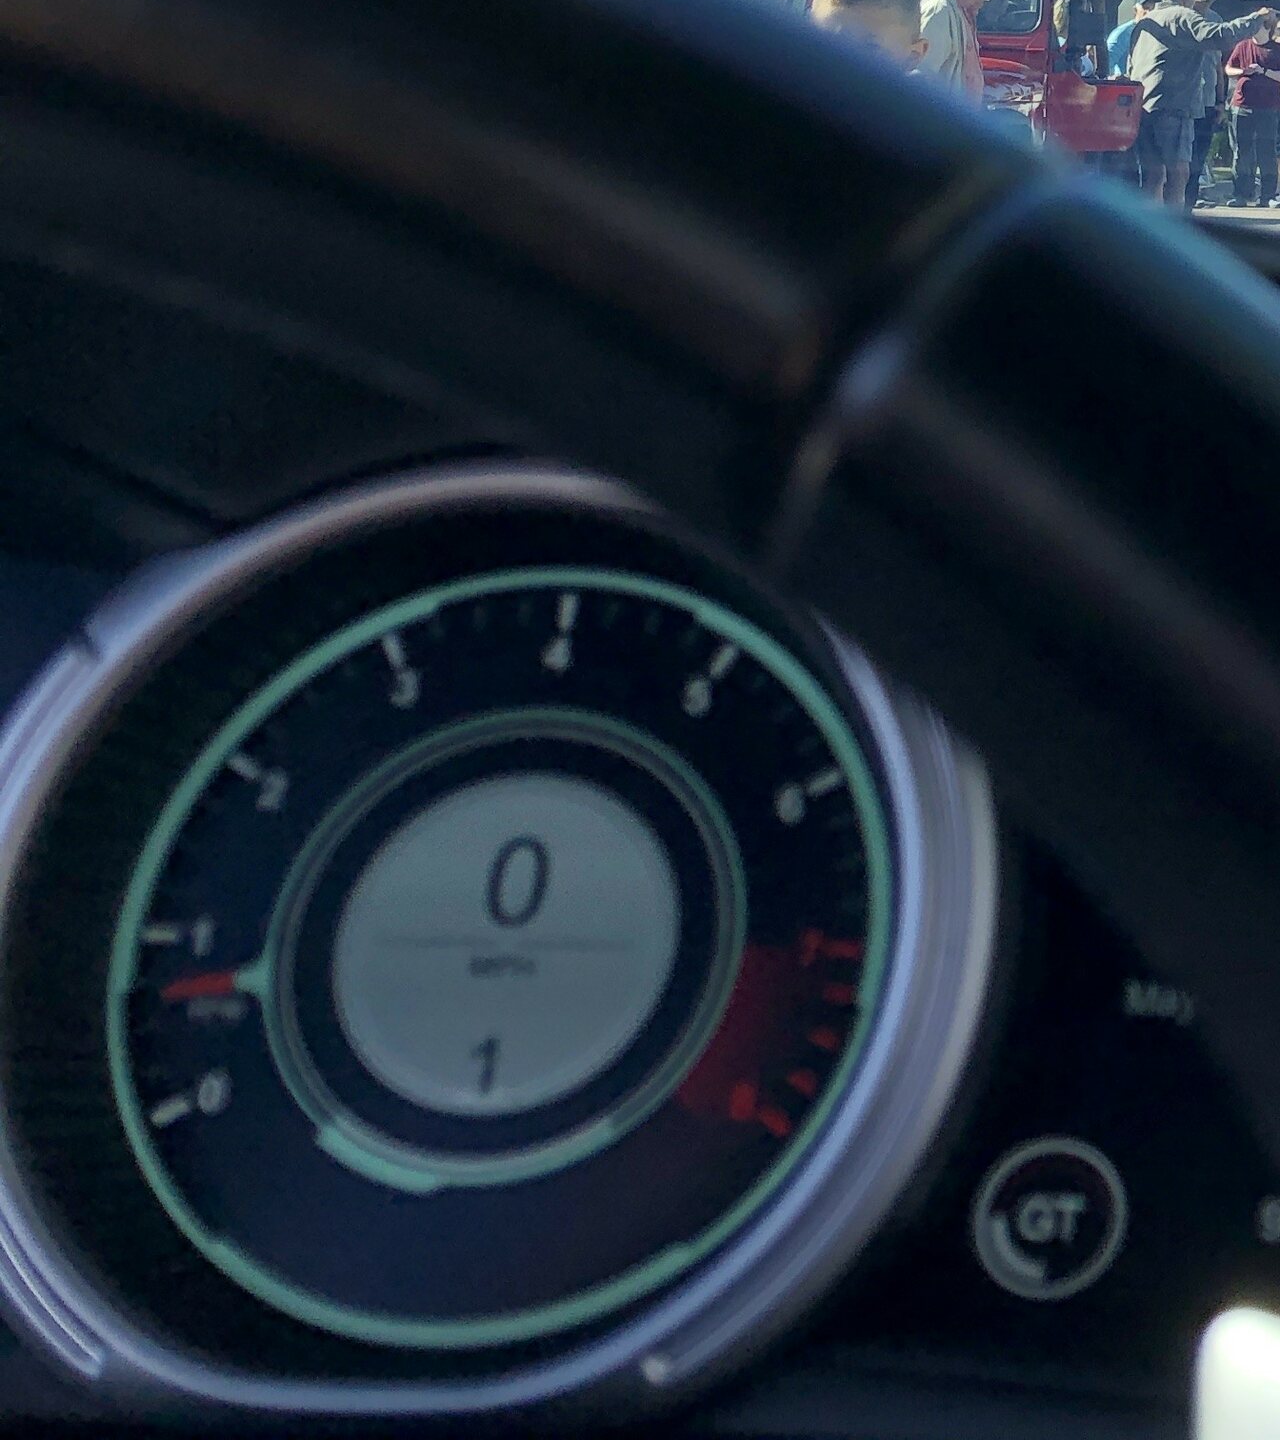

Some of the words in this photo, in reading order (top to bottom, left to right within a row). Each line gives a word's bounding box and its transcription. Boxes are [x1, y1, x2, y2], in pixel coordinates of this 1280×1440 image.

[542, 637, 571, 671] 4
[488, 835, 548, 927] 0
[193, 916, 214, 954] 1
[473, 1037, 496, 1094] 1
[1018, 1194, 1085, 1242] GT
